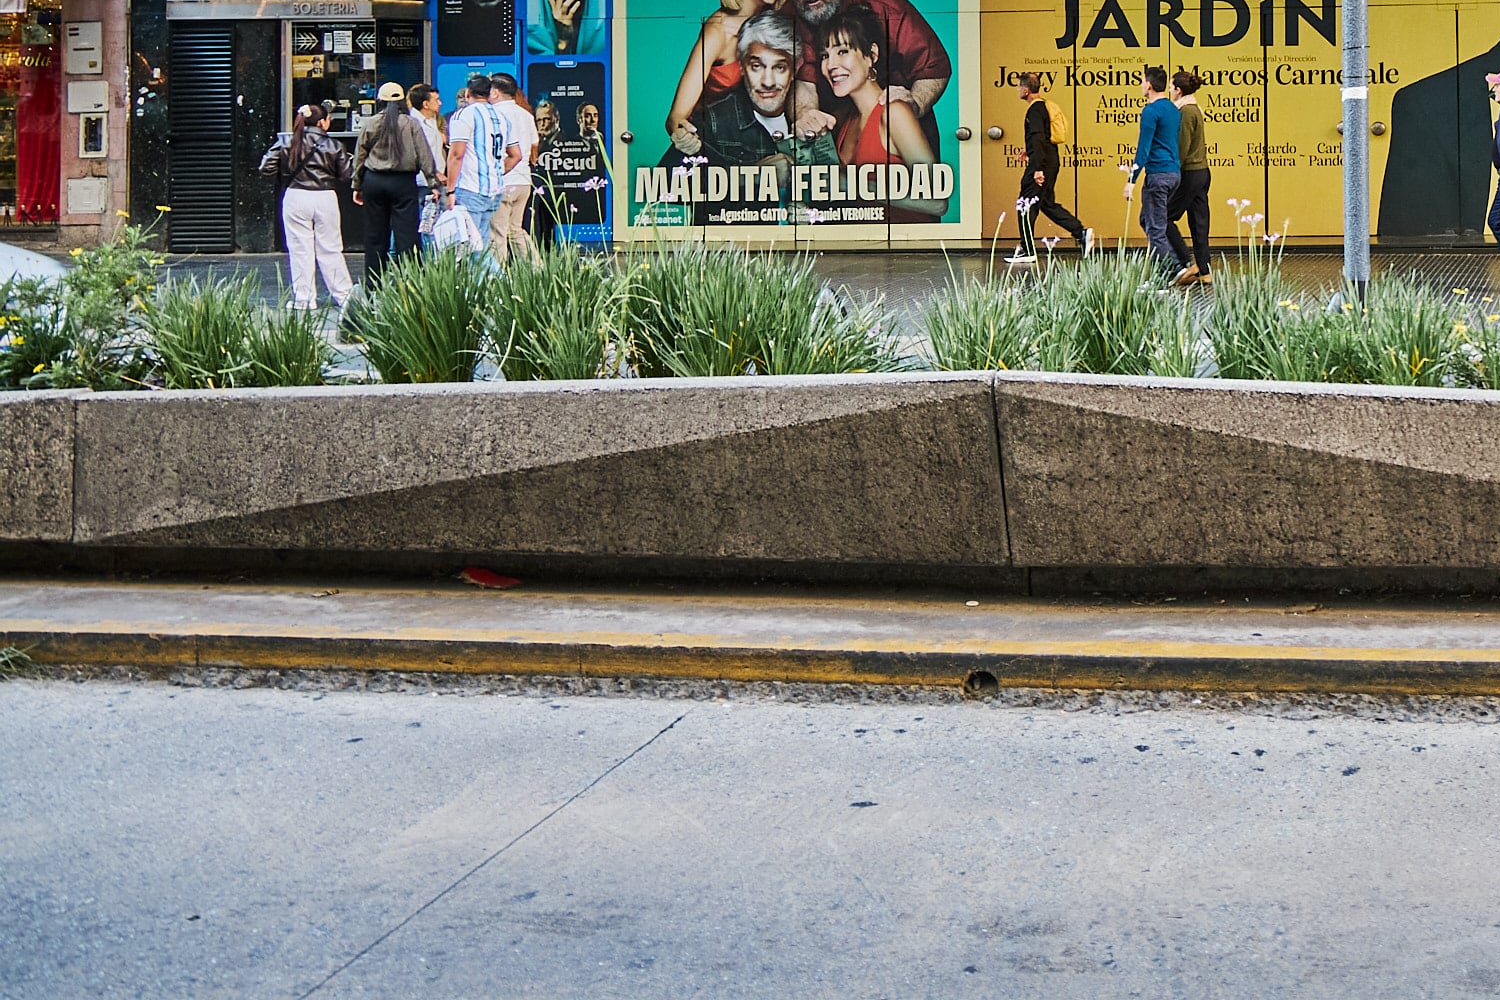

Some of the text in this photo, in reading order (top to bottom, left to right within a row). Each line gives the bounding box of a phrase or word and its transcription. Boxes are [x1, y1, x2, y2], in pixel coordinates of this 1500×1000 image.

[1024, 57, 1049, 65] Basada
[1060, 56, 1067, 64] la
[1254, 55, 1278, 63] tearal
[995, 64, 1164, 93] Jezy Kosins
[1275, 62, 1400, 86] Carneale
[1207, 94, 1261, 108] Martín
[1096, 109, 1143, 127] Friger
[1203, 108, 1260, 123] Seefeld
[490, 133, 504, 160] 10
[1064, 144, 1103, 158] Mayra
[1117, 143, 1137, 155] Die
[1317, 143, 1344, 155] Carl
[538, 147, 597, 171] Freud
[1063, 156, 1105, 168] Homar
[634, 163, 955, 203] MALDITA FELICIDAD
[720, 208, 759, 224] Agustina
[760, 207, 788, 221] GATTO
[842, 206, 885, 221] VERONESE
